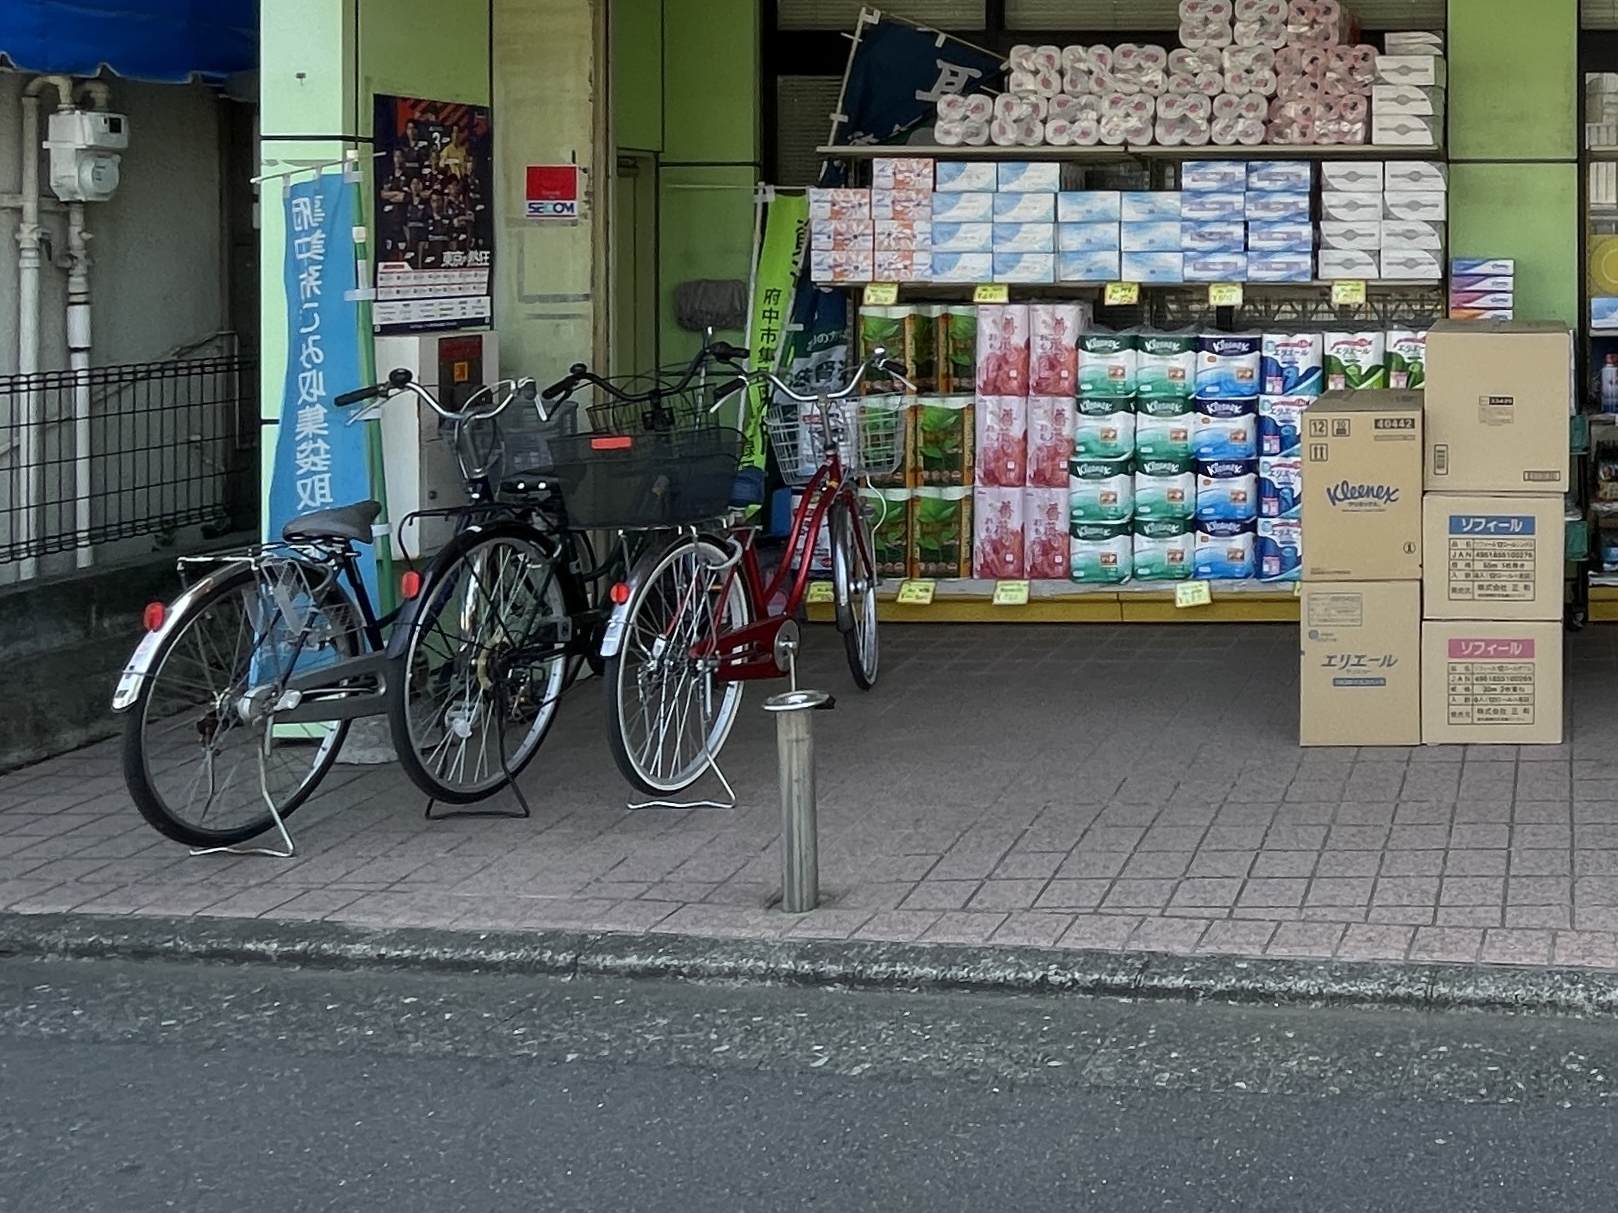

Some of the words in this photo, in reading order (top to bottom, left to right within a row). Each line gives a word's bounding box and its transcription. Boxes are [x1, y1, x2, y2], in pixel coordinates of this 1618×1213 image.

[528, 202, 575, 214] SECOM
[1312, 421, 1325, 434] 12
[1377, 419, 1412, 428] 40442
[1326, 480, 1399, 506] Kleenex
[1462, 518, 1523, 532] ソフィール
[1461, 642, 1523, 655] ソフィール
[1320, 653, 1399, 671] エリエール
